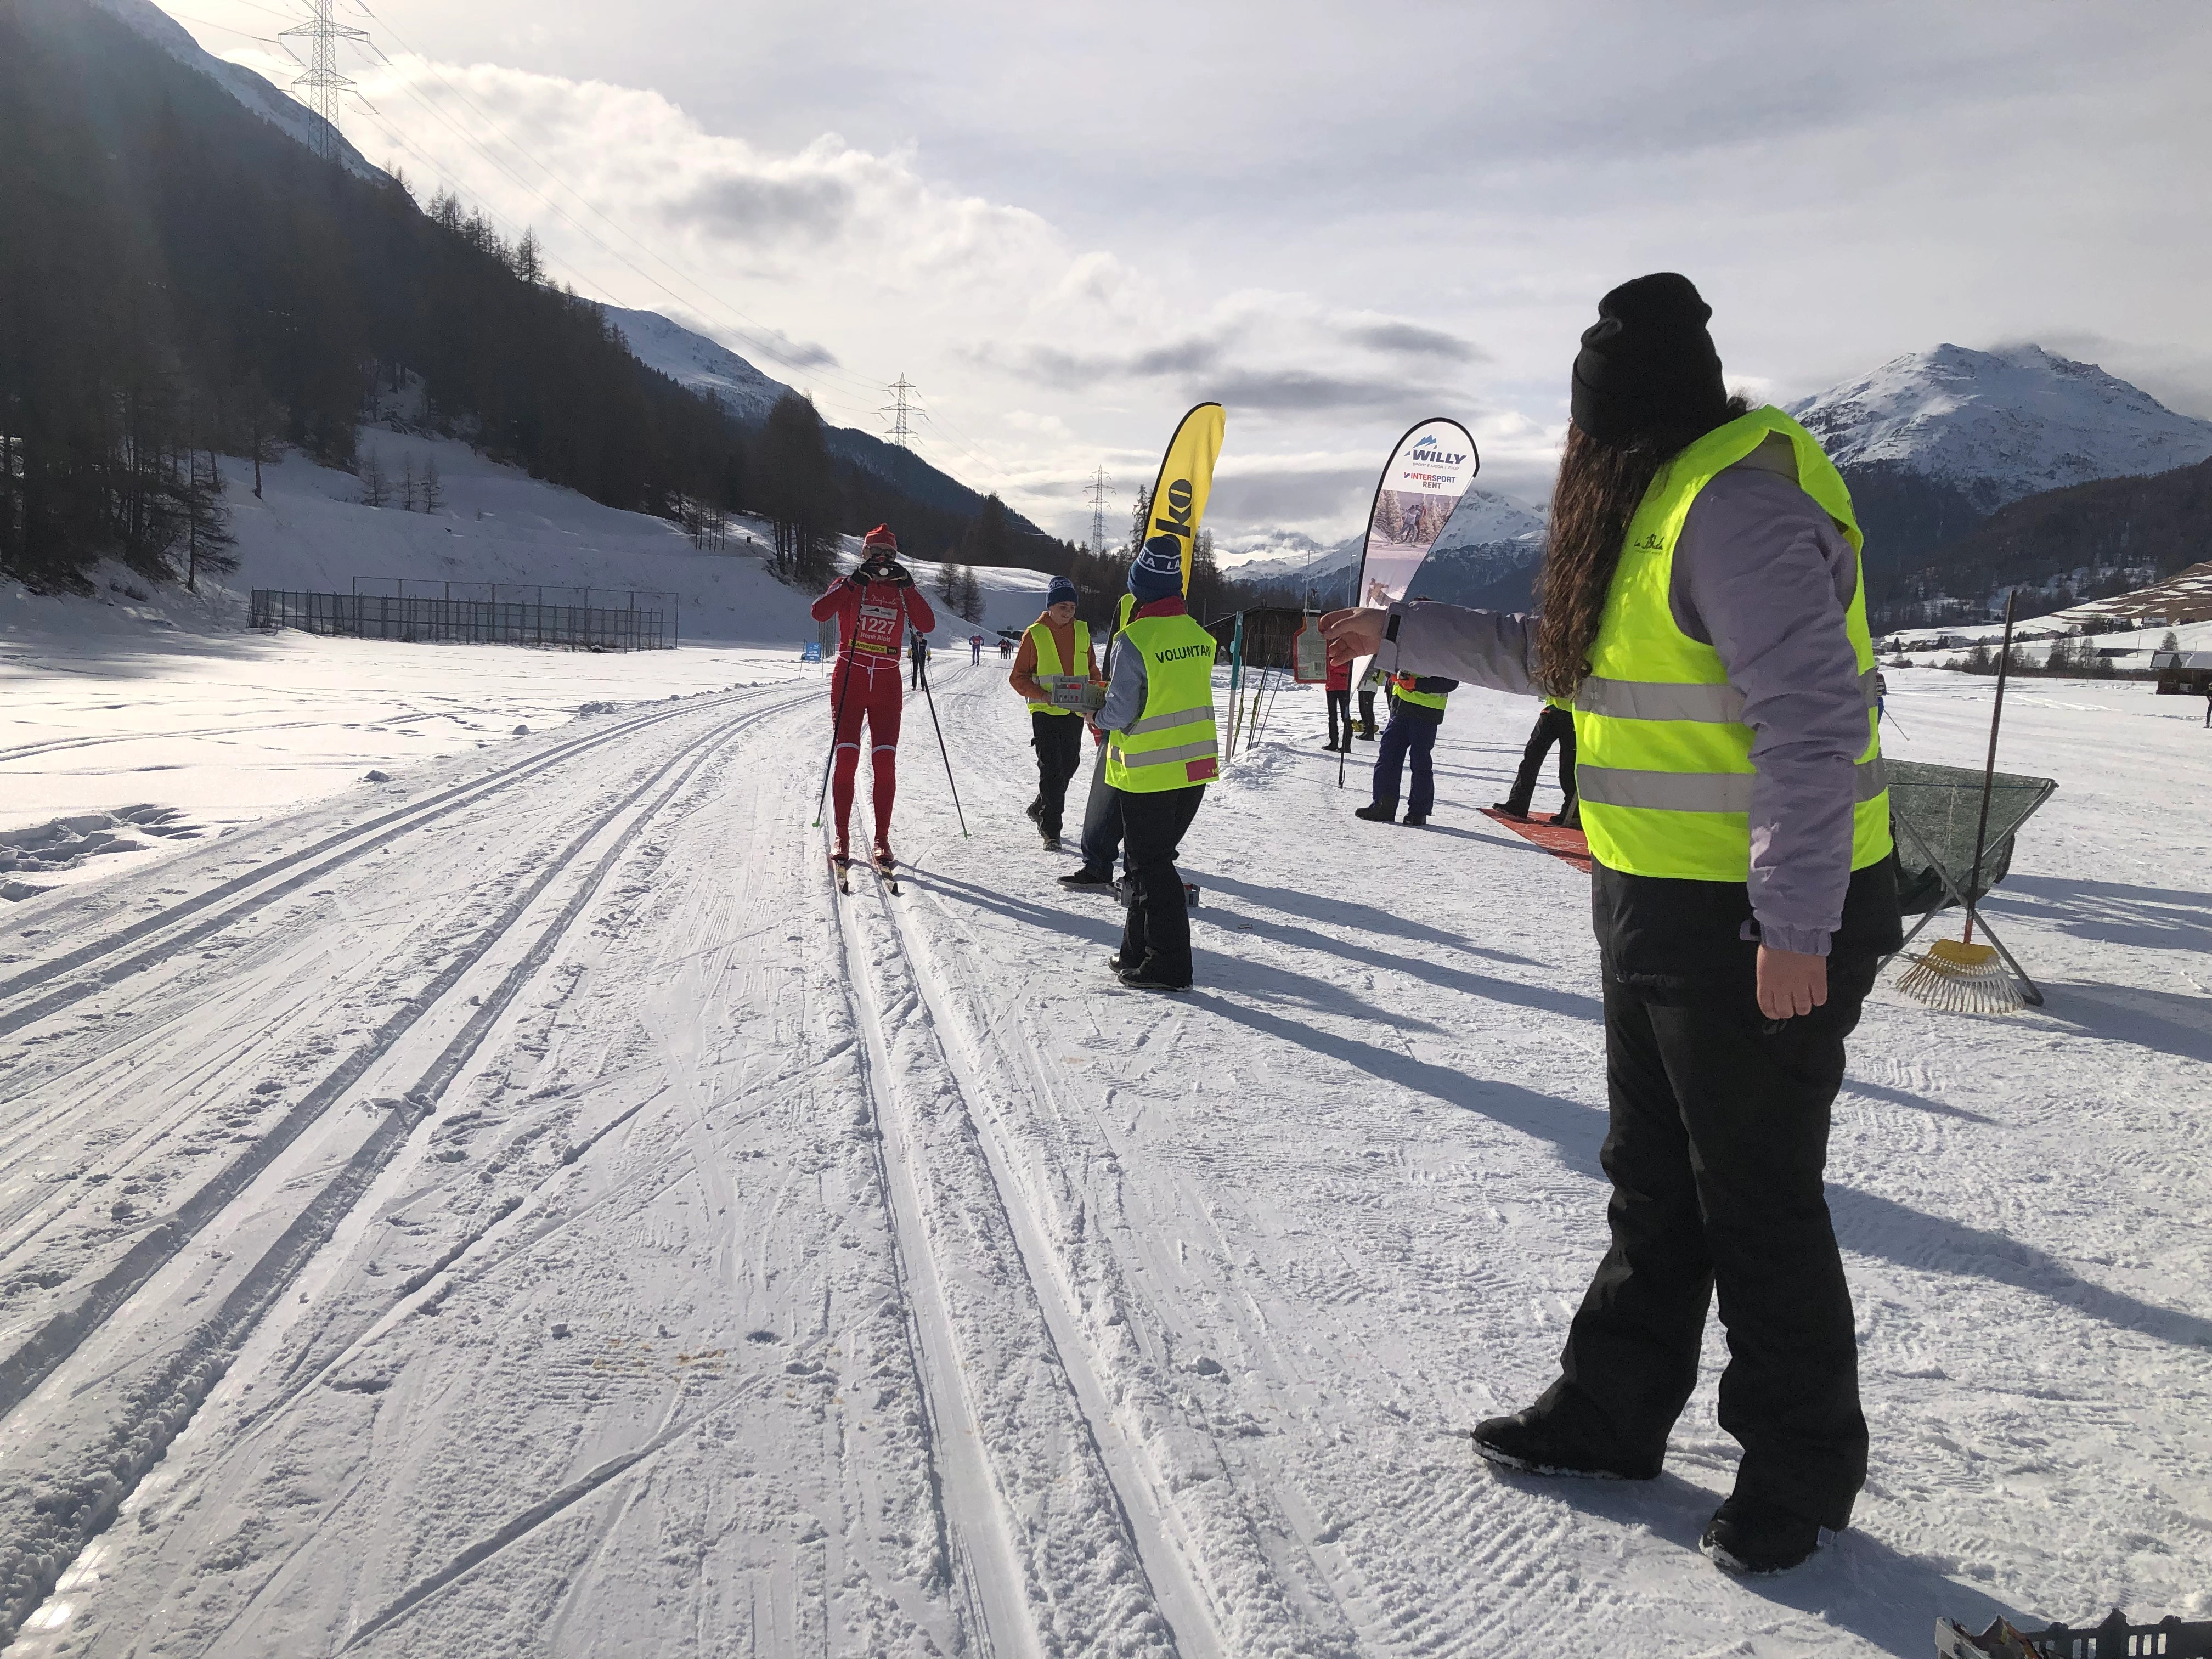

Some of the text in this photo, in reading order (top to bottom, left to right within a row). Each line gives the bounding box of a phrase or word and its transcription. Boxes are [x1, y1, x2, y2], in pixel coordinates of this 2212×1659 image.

[1413, 449, 1467, 464] WILLY
[1410, 473, 1455, 483] INTERSPORT
[1423, 481, 1442, 489] RENT
[1155, 479, 1193, 543] ko
[860, 617, 896, 635] 1227
[1155, 645, 1211, 664] VOLUNTARI
